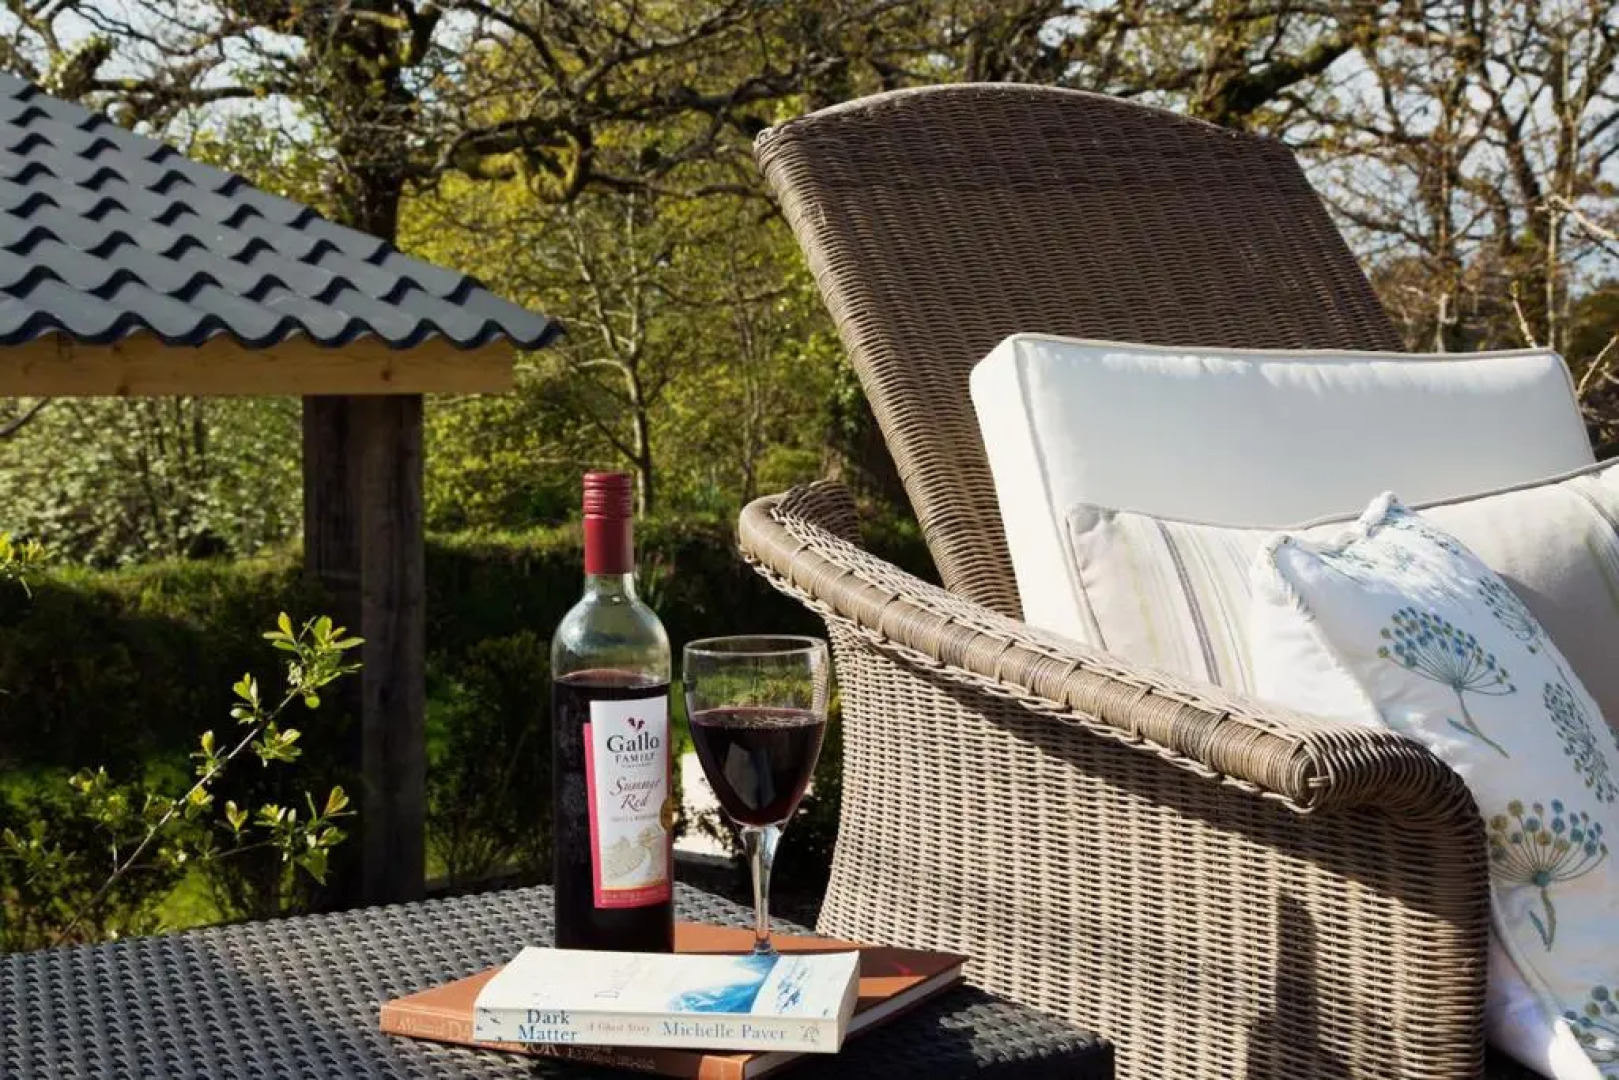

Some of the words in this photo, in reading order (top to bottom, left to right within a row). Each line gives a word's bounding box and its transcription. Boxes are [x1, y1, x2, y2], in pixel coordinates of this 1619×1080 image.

[606, 732, 660, 753] Gallo
[608, 777, 662, 796] Summer
[620, 788, 652, 811] Red
[527, 1009, 570, 1025] Dark
[518, 1024, 579, 1041] Matter
[663, 1020, 735, 1038] Michelle
[741, 1023, 787, 1039] Paver
